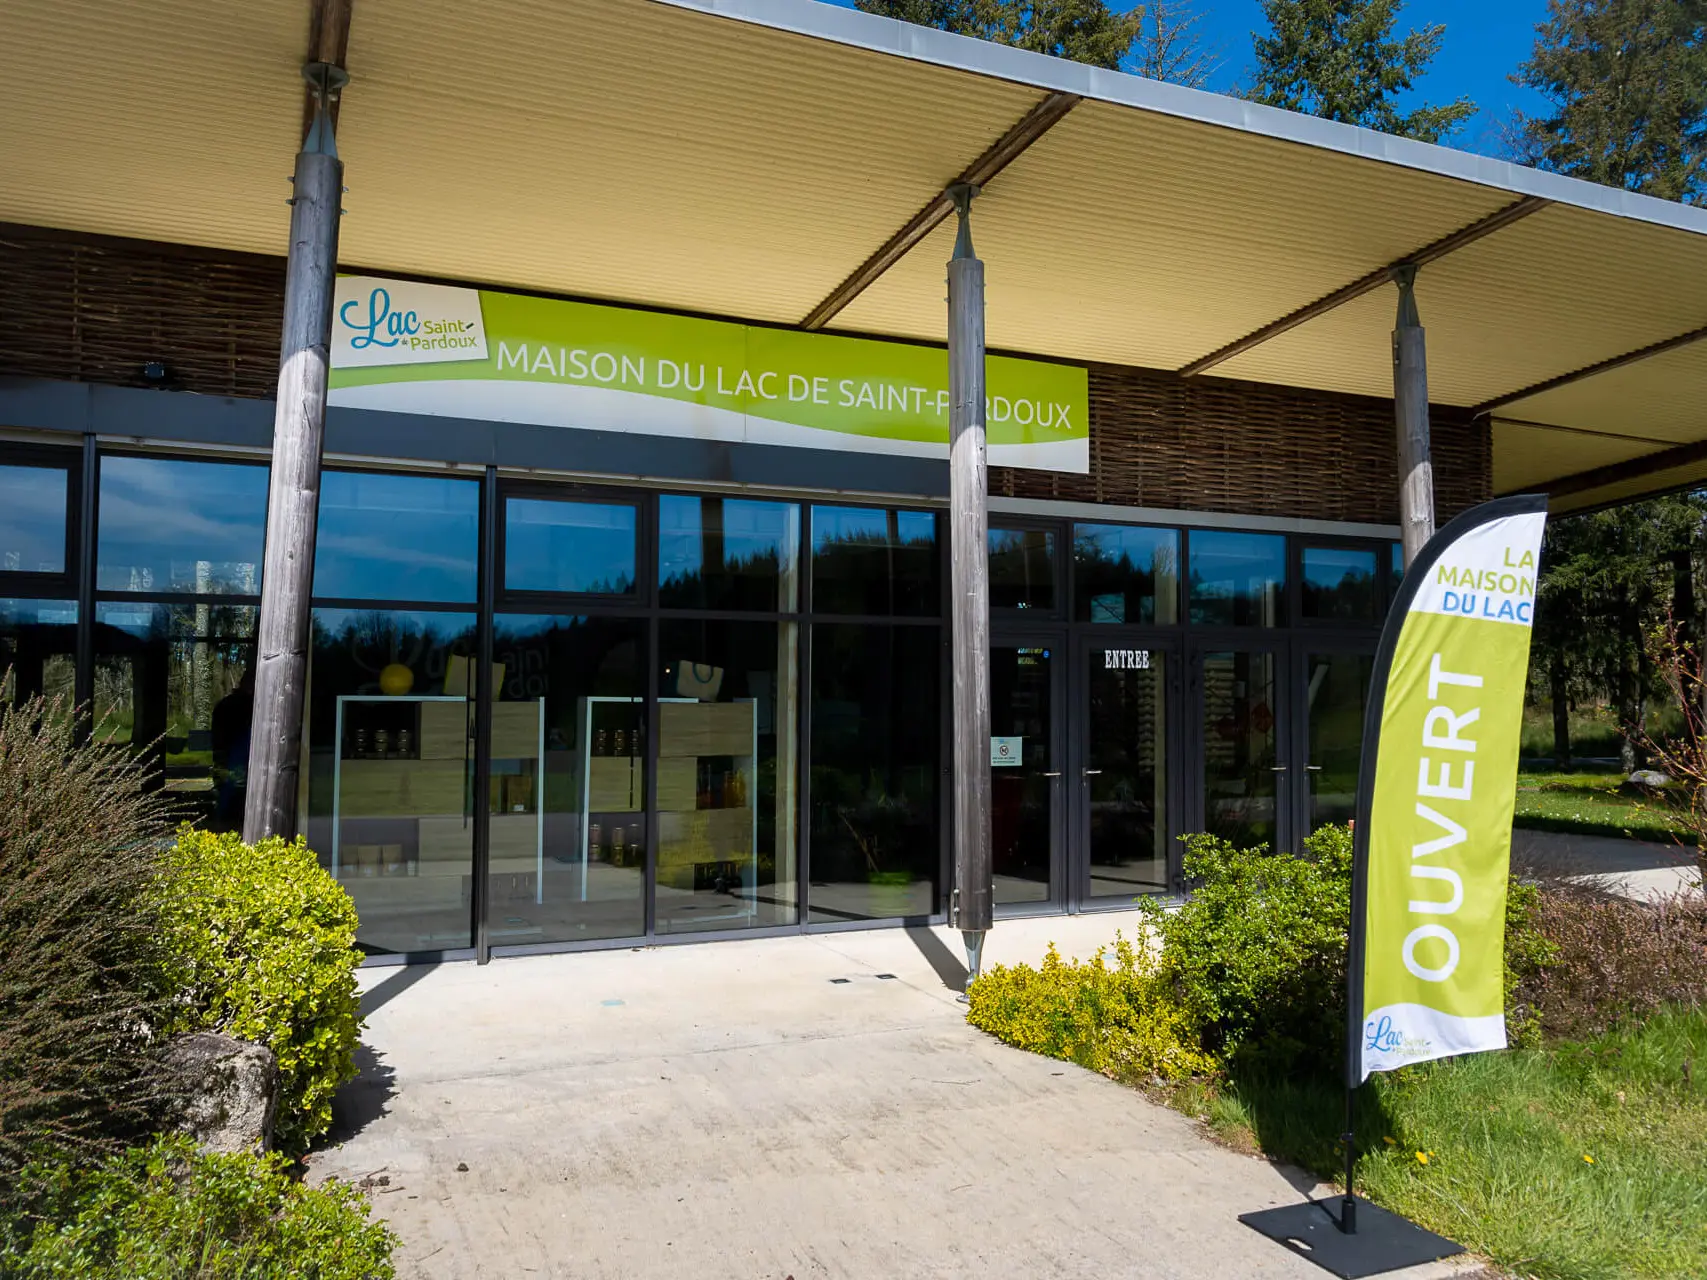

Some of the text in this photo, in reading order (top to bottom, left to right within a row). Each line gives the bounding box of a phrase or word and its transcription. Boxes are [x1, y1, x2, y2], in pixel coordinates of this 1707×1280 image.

[340, 288, 421, 349] Lac
[410, 334, 478, 351] Pardoux
[496, 341, 1072, 430] MAISON DU LAC DE SAINT-PDOUX
[1503, 546, 1534, 570] LA
[1437, 565, 1534, 598] MAISON
[1442, 591, 1532, 622] DU LAC
[1104, 649, 1150, 669] ENTREE
[1402, 653, 1483, 982] OUVERT
[1366, 1015, 1403, 1052] Lac
